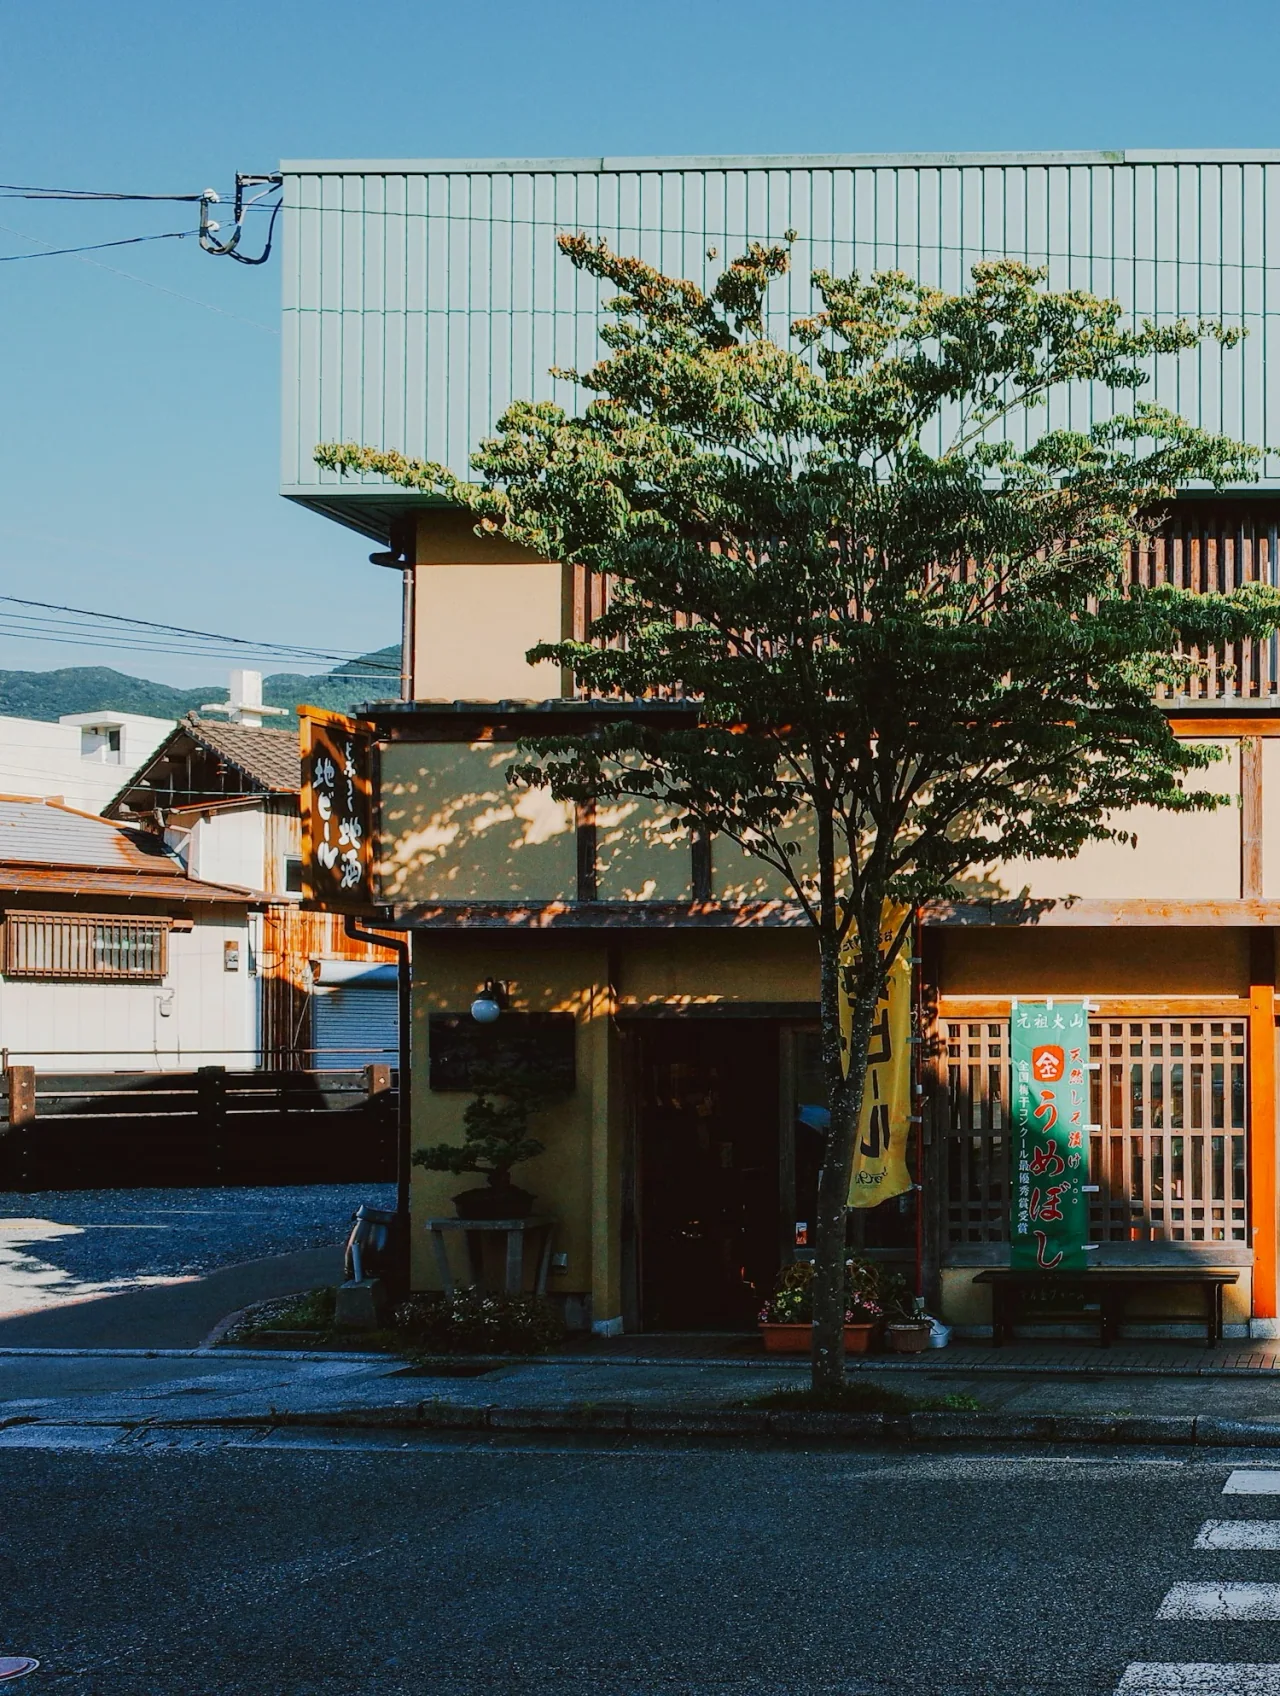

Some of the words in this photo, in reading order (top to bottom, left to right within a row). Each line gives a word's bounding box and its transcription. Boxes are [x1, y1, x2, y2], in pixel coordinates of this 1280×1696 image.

[313, 757, 339, 870] 地ビール
[338, 816, 362, 889] 地酒
[1029, 1089, 1071, 1270] うめぼし
